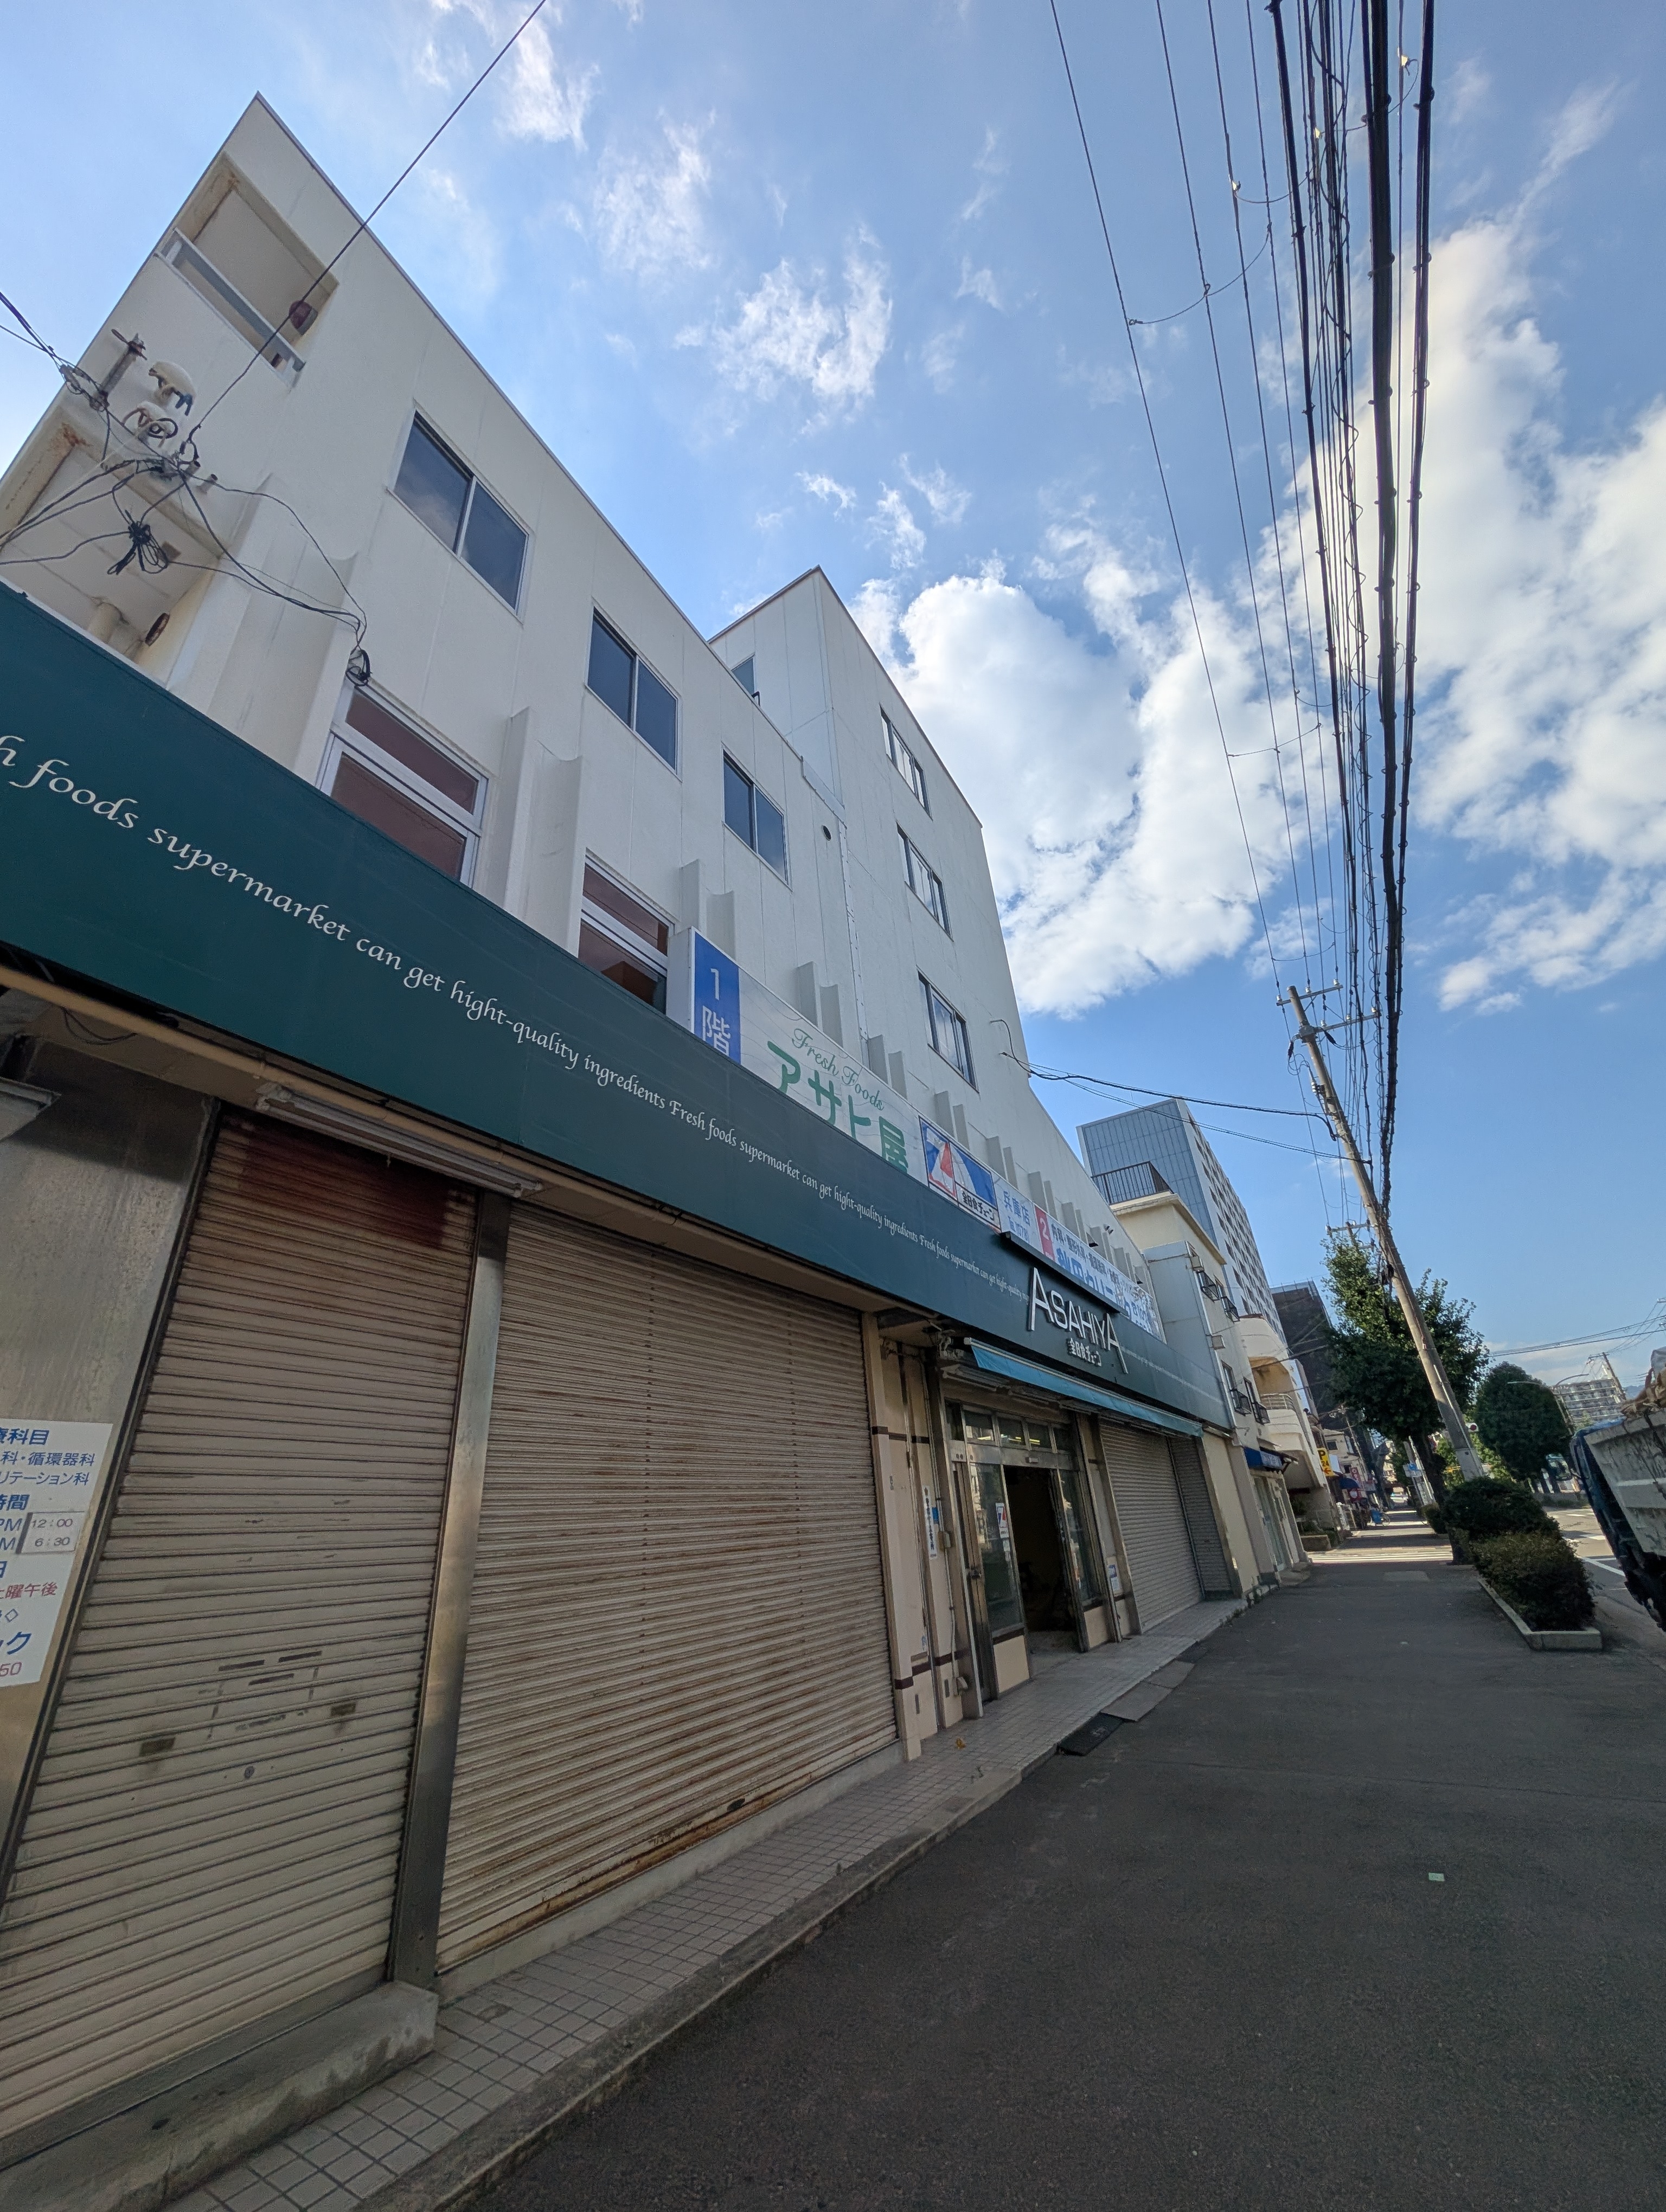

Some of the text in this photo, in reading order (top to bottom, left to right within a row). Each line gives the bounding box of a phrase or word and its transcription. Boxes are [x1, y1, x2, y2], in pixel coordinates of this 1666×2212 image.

[9, 760, 139, 828] foods
[148, 828, 351, 941] supermarket
[356, 939, 401, 969] can
[403, 967, 445, 991] get
[451, 980, 579, 1070] hight-quality
[584, 1055, 665, 1109] ingredients
[669, 1101, 705, 1130] Fresh
[705, 1118, 736, 1146] foods
[740, 1141, 800, 1180] supermarket
[803, 1174, 818, 1189] can
[819, 1184, 831, 1199] get
[834, 1186, 882, 1229] hight-quality
[884, 1215, 918, 1243] ingredients
[919, 1234, 935, 1252] Fresh
[936, 1241, 950, 1259] foods
[792, 1028, 885, 1110] Fresh Foods
[1029, 1267, 1128, 1374] ASAHIYA
[0, 1471, 89, 1486] リテーション科
[1, 1451, 95, 1466] 科・循環器科
[1318, 1450, 1326, 1460] P
